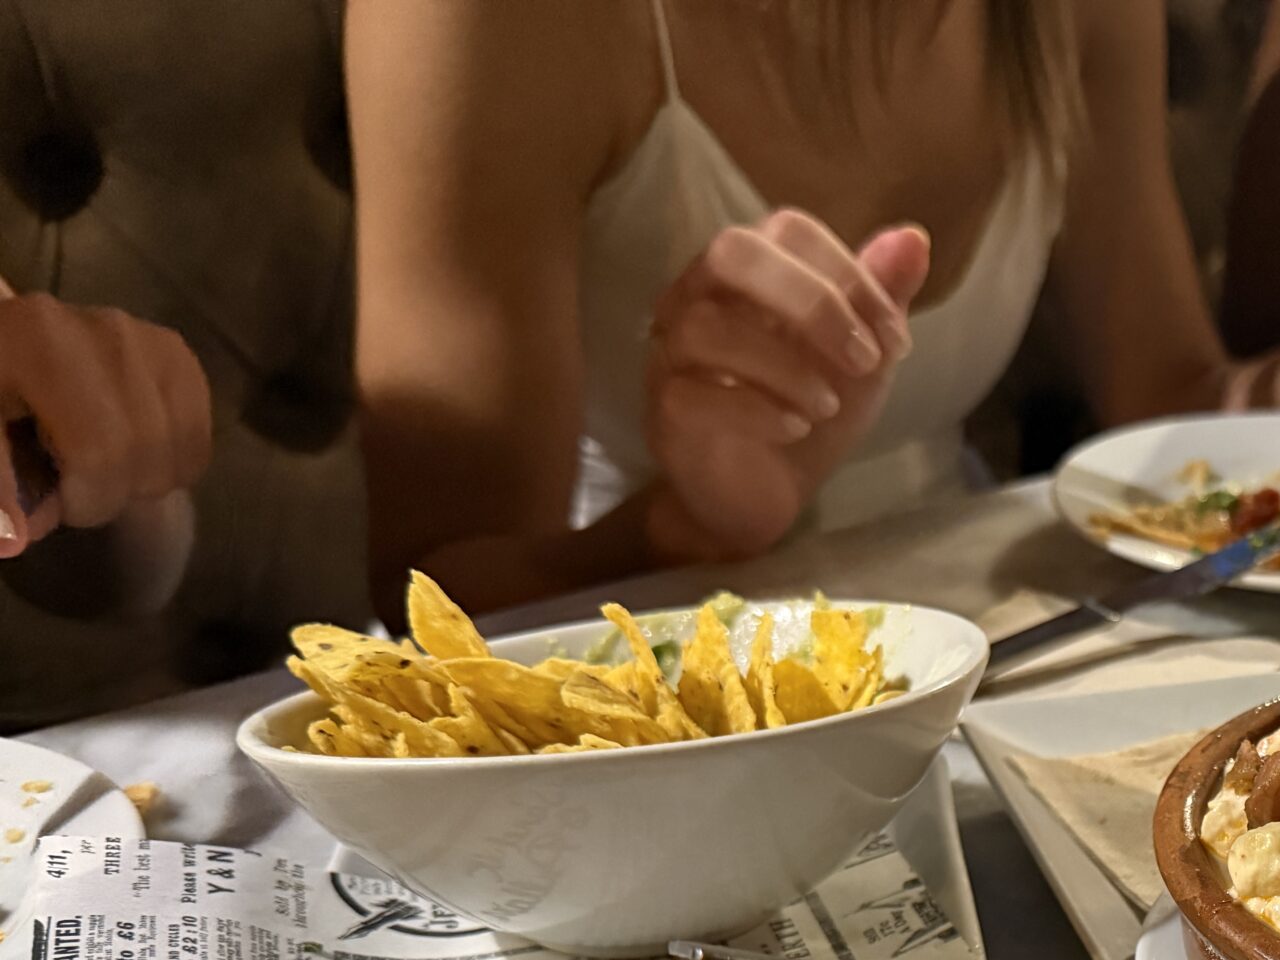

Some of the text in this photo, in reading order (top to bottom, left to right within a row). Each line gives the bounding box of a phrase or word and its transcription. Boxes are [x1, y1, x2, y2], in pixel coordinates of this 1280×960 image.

[104, 836, 121, 874] THREE
[180, 872, 196, 904] Please
[206, 850, 234, 894] Y & N
[116, 921, 134, 940] £6
[168, 923, 180, 947] CYCLES
